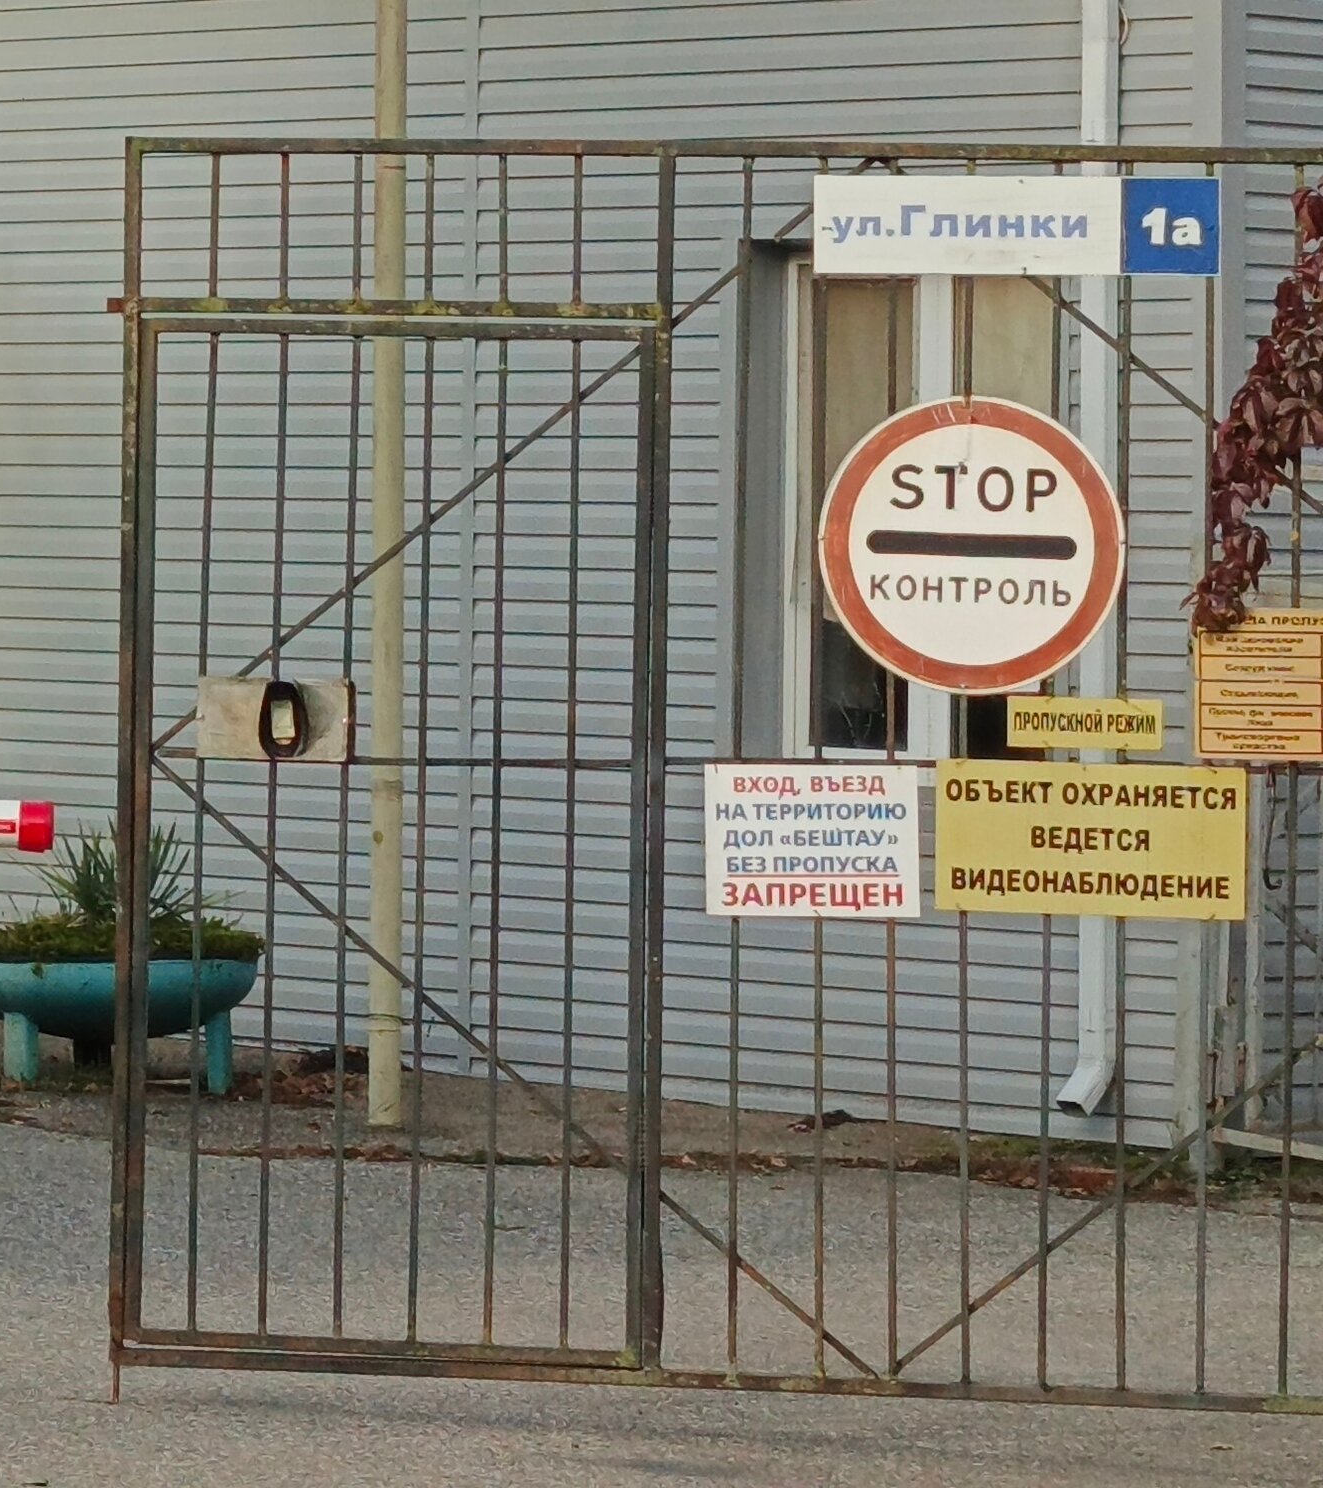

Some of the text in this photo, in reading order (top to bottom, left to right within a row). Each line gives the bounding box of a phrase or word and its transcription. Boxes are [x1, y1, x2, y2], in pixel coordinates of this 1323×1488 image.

[1141, 208, 1202, 246] 1а
[891, 464, 1058, 512] STOP
[870, 574, 1073, 607] КОНТРОЛЬ
[1013, 711, 1157, 734] ПРОПУСКНОЙ РЕЖИМ
[733, 775, 886, 799] ВХОД, ВЪЕЗД
[946, 779, 1237, 810] ОБЪЕКТ ОХРАНЯЕТСЯ
[716, 803, 907, 821] НА ТЕРРИТОРИЮ
[723, 828, 898, 850] ДОЛ «БЕШТАУ»
[1030, 825, 1150, 854] ВЕДЕТСЯ
[727, 856, 898, 873] БЕЗ ПРОПУСКА
[722, 882, 903, 911] ЗАПРЕЩЕН
[951, 867, 1230, 901] ВИДЕОНАБЛЮДЕНИЕ
